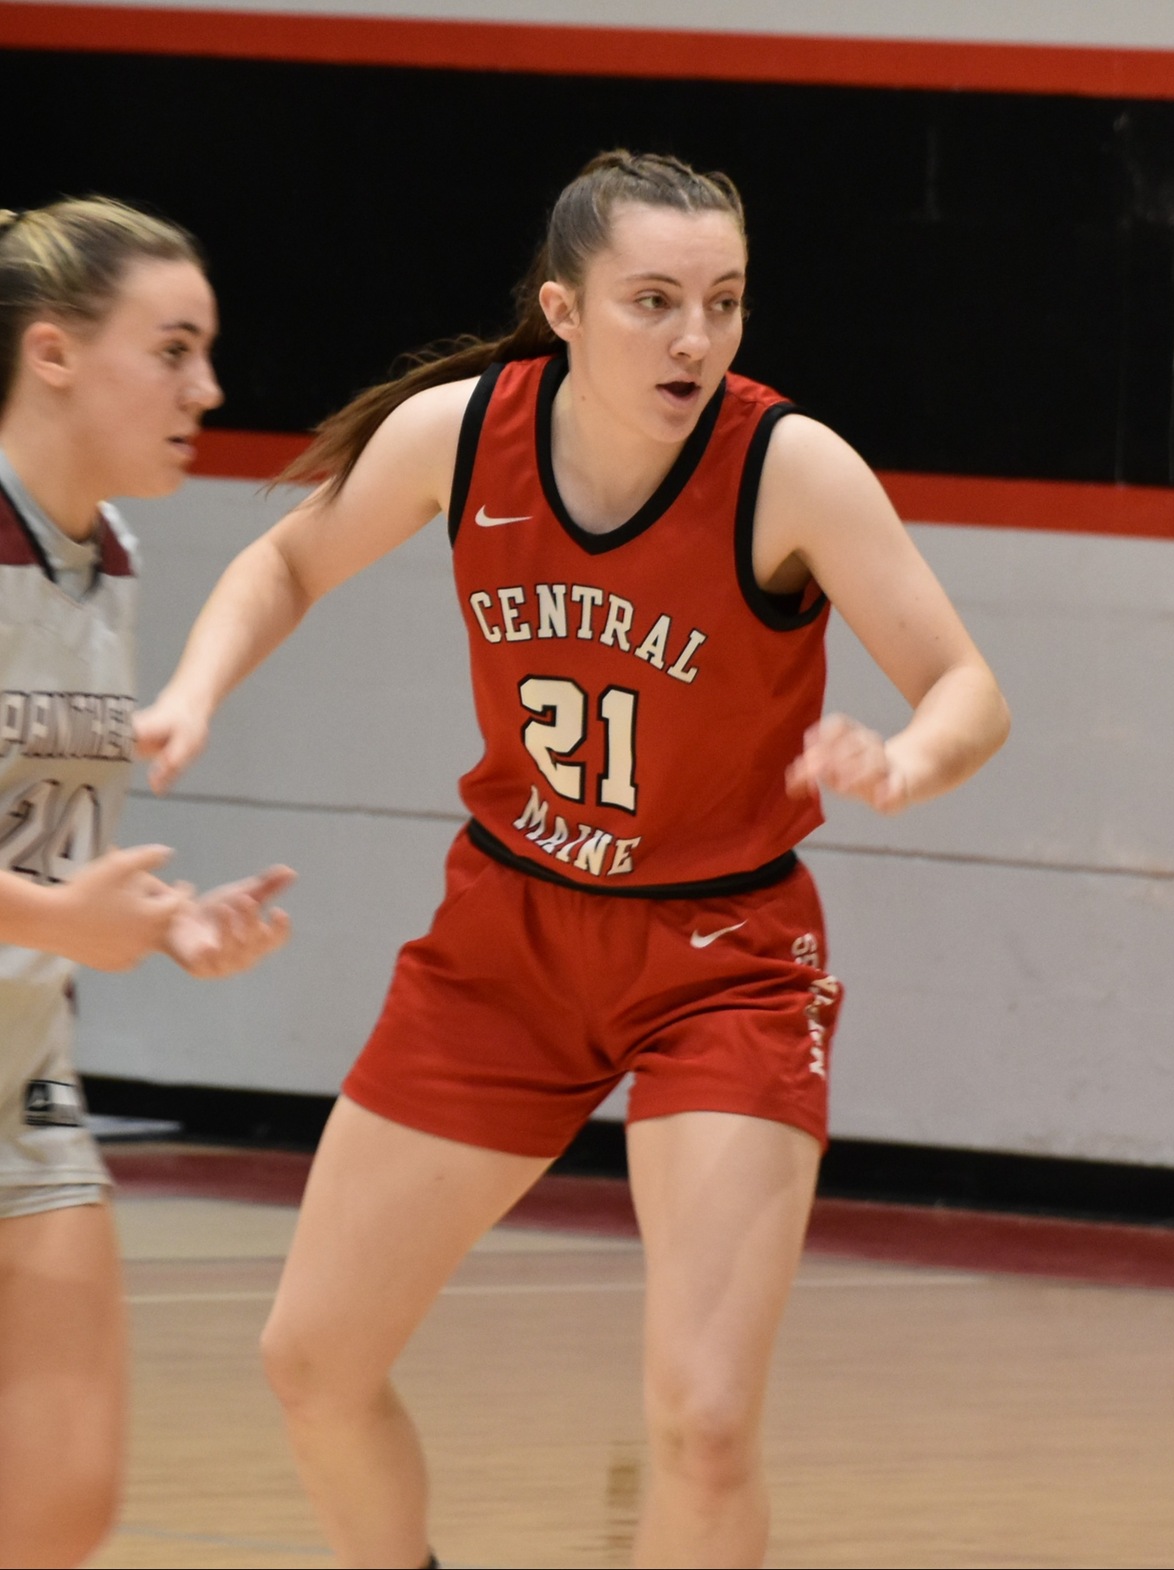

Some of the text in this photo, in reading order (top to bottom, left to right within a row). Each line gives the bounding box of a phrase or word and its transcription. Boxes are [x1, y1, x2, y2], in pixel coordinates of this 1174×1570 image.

[468, 582, 708, 685] CENTRAL
[517, 673, 640, 817] 21
[511, 783, 643, 877] MAINE
